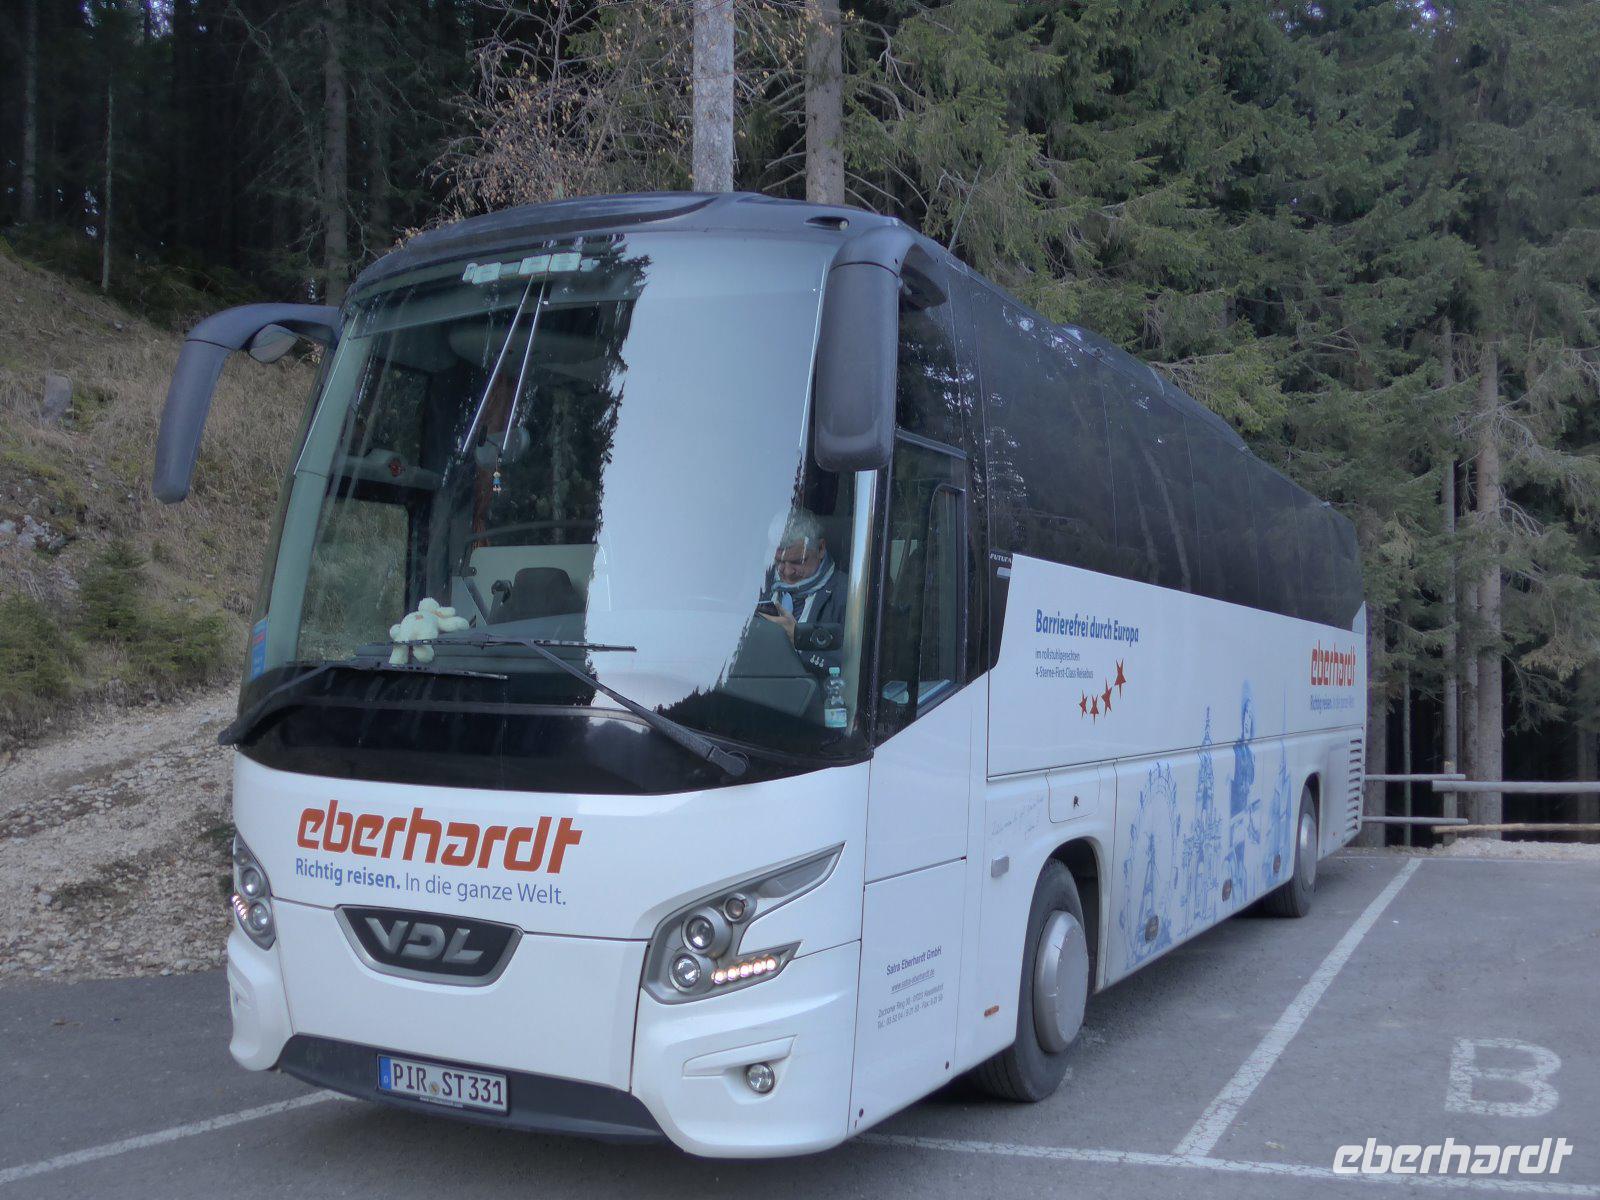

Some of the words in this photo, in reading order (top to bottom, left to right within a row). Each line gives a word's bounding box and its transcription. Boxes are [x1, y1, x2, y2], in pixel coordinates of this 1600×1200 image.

[1035, 608, 1089, 638] Barrierefrei
[1090, 615, 1112, 640] durch
[1113, 619, 1139, 647] Europa
[1310, 639, 1356, 687] eberhardt
[297, 799, 583, 874] eberhardt
[295, 857, 343, 887] Richtig
[347, 864, 401, 890] reisen.
[405, 872, 421, 892] In
[425, 874, 452, 896] die
[457, 879, 513, 902] ganze
[517, 882, 567, 906] Welt.
[365, 917, 485, 965] VDL
[901, 952, 926, 970] Eberhardt
[926, 945, 942, 960] GmbH
[393, 1063, 428, 1092] PIR
[1445, 1037, 1561, 1118] B
